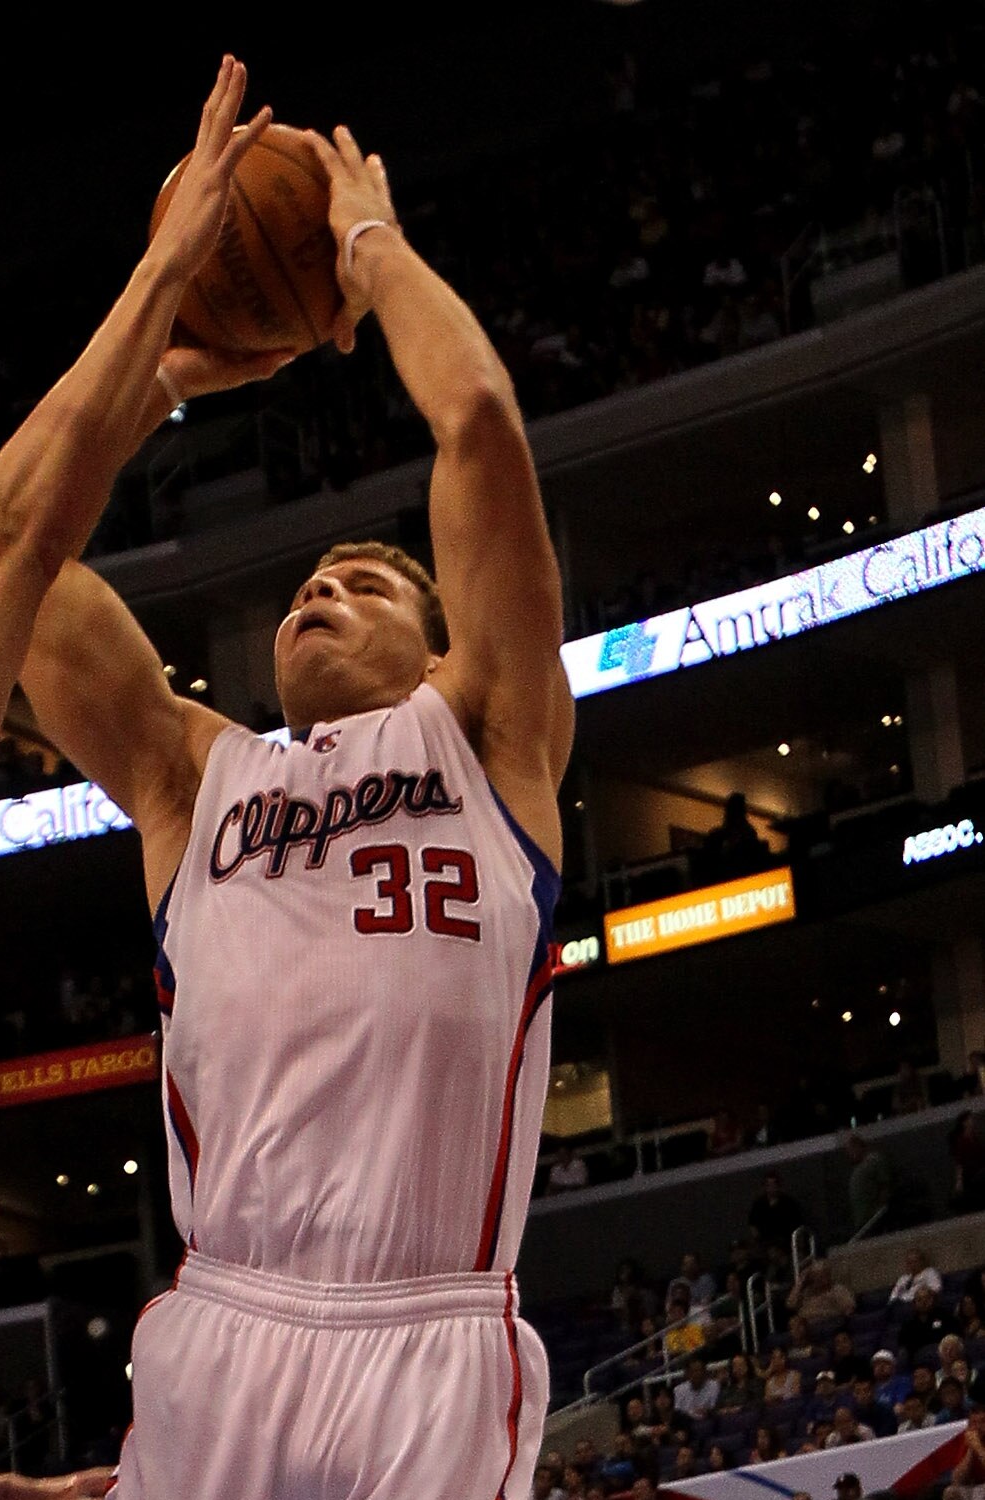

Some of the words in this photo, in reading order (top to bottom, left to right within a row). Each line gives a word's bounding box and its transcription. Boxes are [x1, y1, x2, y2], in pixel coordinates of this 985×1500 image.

[679, 568, 843, 669] Amtrak
[209, 769, 463, 885] Clippers
[349, 844, 481, 942] 32
[610, 915, 656, 949] THE
[659, 898, 718, 938] HOME
[720, 881, 790, 921] DEPOT
[69, 1046, 156, 1081] FARGO
